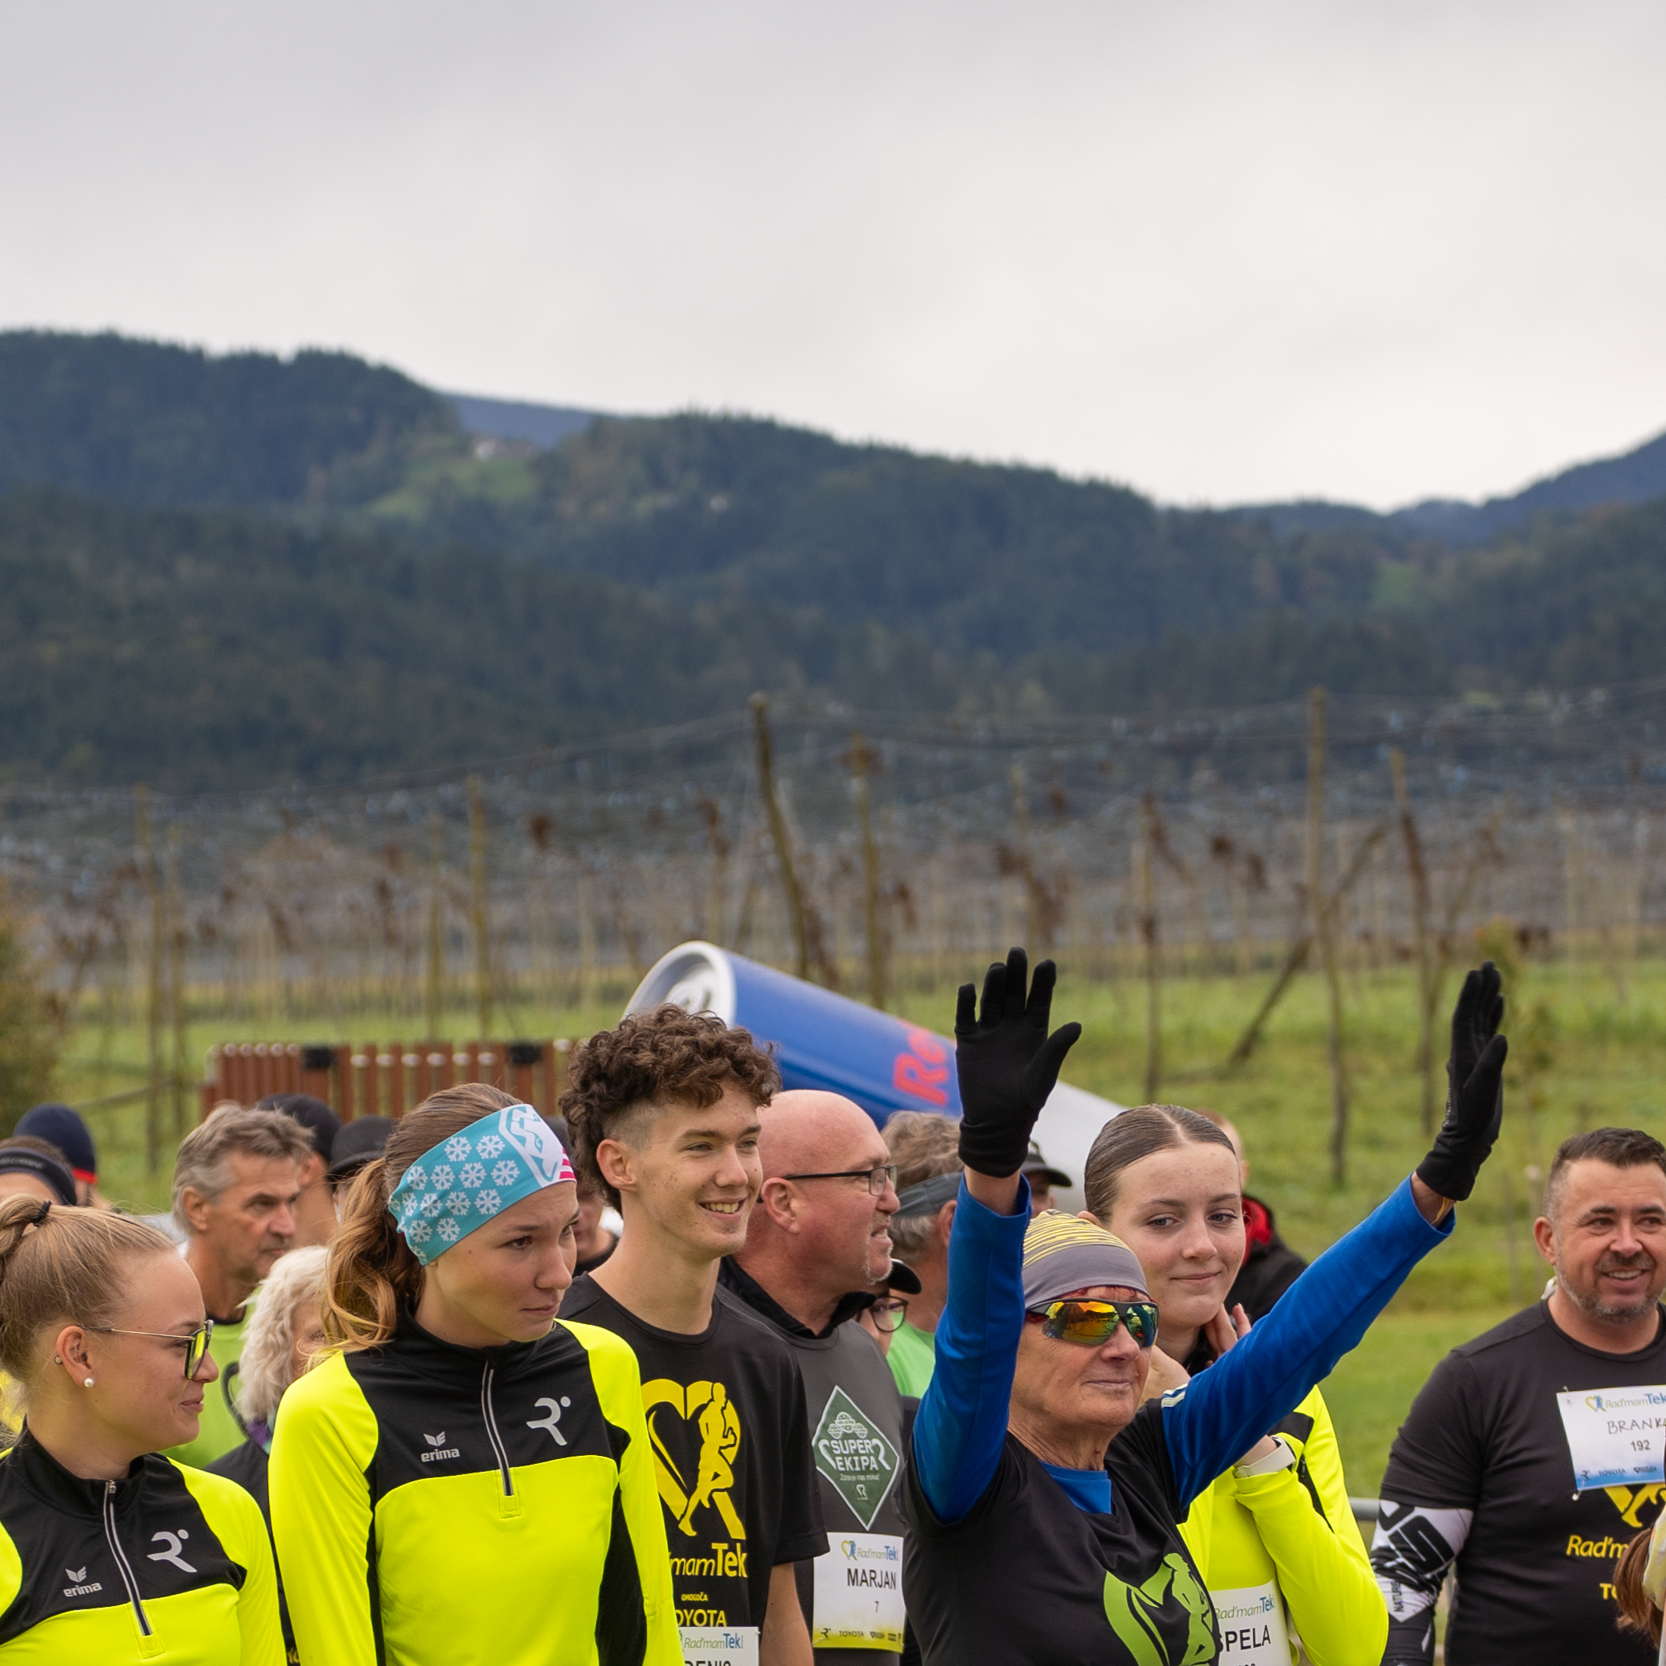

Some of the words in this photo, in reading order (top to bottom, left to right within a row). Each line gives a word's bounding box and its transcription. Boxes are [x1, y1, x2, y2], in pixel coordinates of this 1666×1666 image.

[830, 1439, 875, 1455] SUPER
[1630, 1439, 1651, 1451] 192
[421, 1448, 460, 1462] erima
[835, 1455, 879, 1472] EKIPA
[847, 1568, 897, 1590] MARJAN
[63, 1582, 102, 1597] erima
[874, 1601, 880, 1614] 7
[838, 1630, 864, 1638] TOYOTA
[1219, 1625, 1271, 1653] PELA
